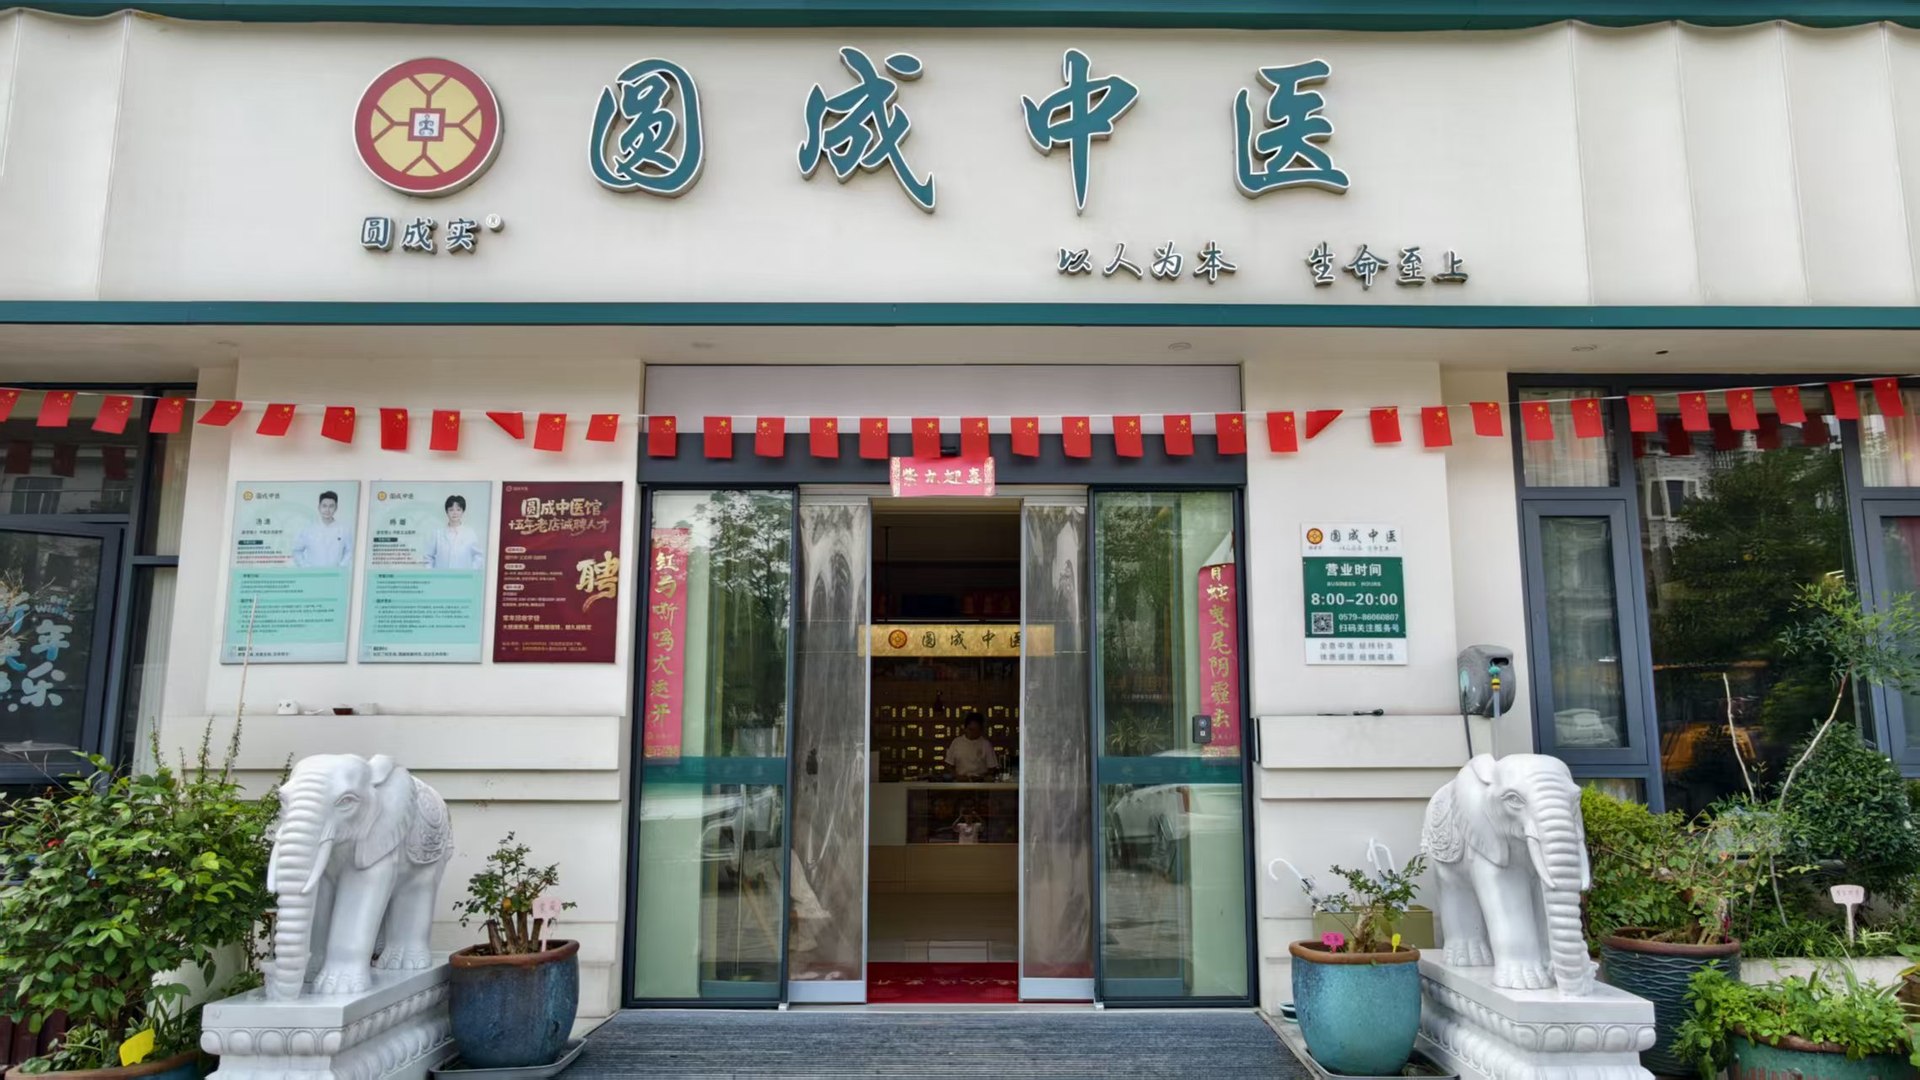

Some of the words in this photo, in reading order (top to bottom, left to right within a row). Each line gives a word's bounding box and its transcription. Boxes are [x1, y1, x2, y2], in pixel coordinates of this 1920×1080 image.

[588, 44, 1351, 215] 圆成中医
[1057, 241, 1237, 285] 以人为本
[1307, 240, 1468, 291] 生命至上
[521, 497, 603, 518] 圆成中医馆
[508, 517, 610, 536] 十五年老店诚聘人才
[1330, 528, 1398, 543] 圆成中医
[1325, 563, 1382, 577] 营业时间
[576, 550, 620, 613] 聘
[1311, 593, 1398, 606] 8:00-20:00
[1339, 623, 1400, 633] 扫码关注服务号
